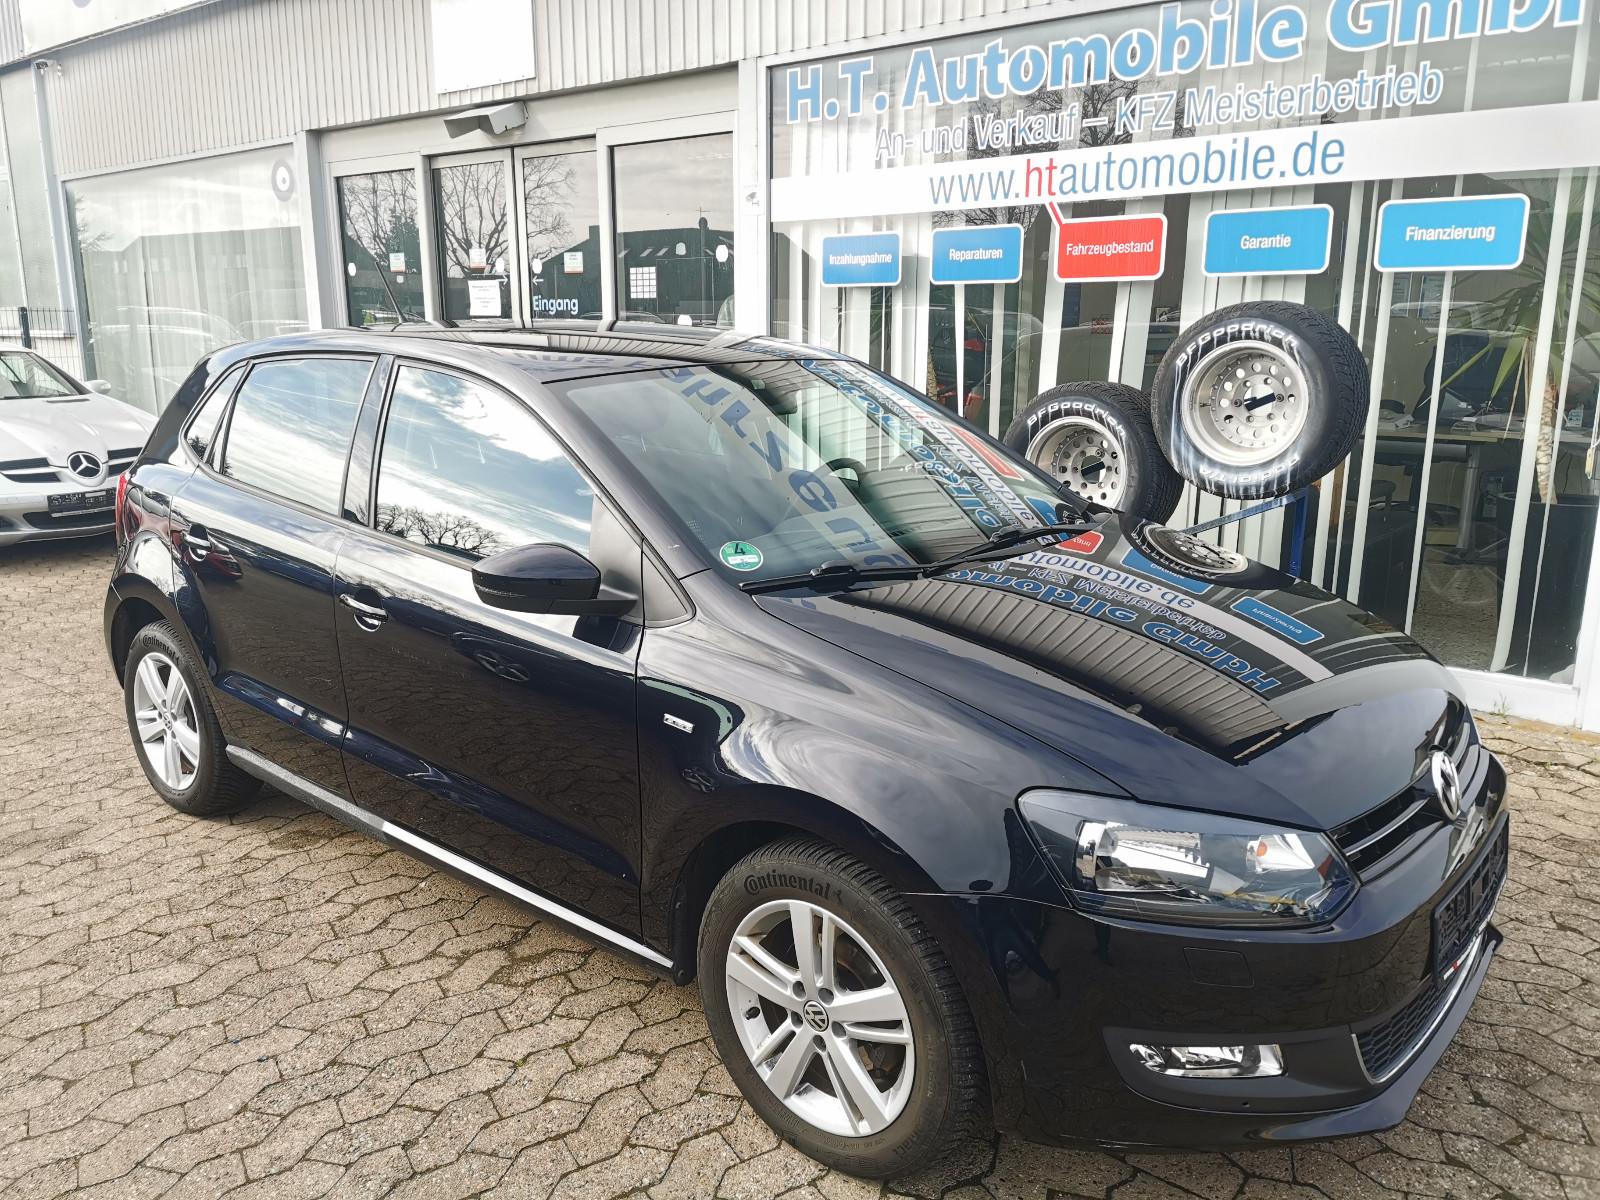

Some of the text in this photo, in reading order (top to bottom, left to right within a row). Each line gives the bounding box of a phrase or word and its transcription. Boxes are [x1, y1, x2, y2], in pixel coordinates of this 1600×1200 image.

[786, 56, 890, 125] H.T.
[901, 0, 1308, 111] Automobile
[876, 127, 913, 161] An-
[922, 116, 968, 155] und
[974, 105, 1077, 149] Verkauf
[1115, 91, 1177, 136] KFZ
[1183, 61, 1446, 128] Meisterbetrieb
[929, 130, 1345, 205] www.htautomobile.de
[1240, 234, 1292, 250] Garantie
[1405, 224, 1496, 244] Finanzierung
[949, 246, 1003, 262] Reparaturen
[1065, 239, 1154, 257] Fahrzeugbestand
[829, 251, 893, 267] Inzahlungnahme
[533, 295, 579, 315] Eingang
[734, 543, 746, 555] 4
[743, 868, 832, 900] Continental
